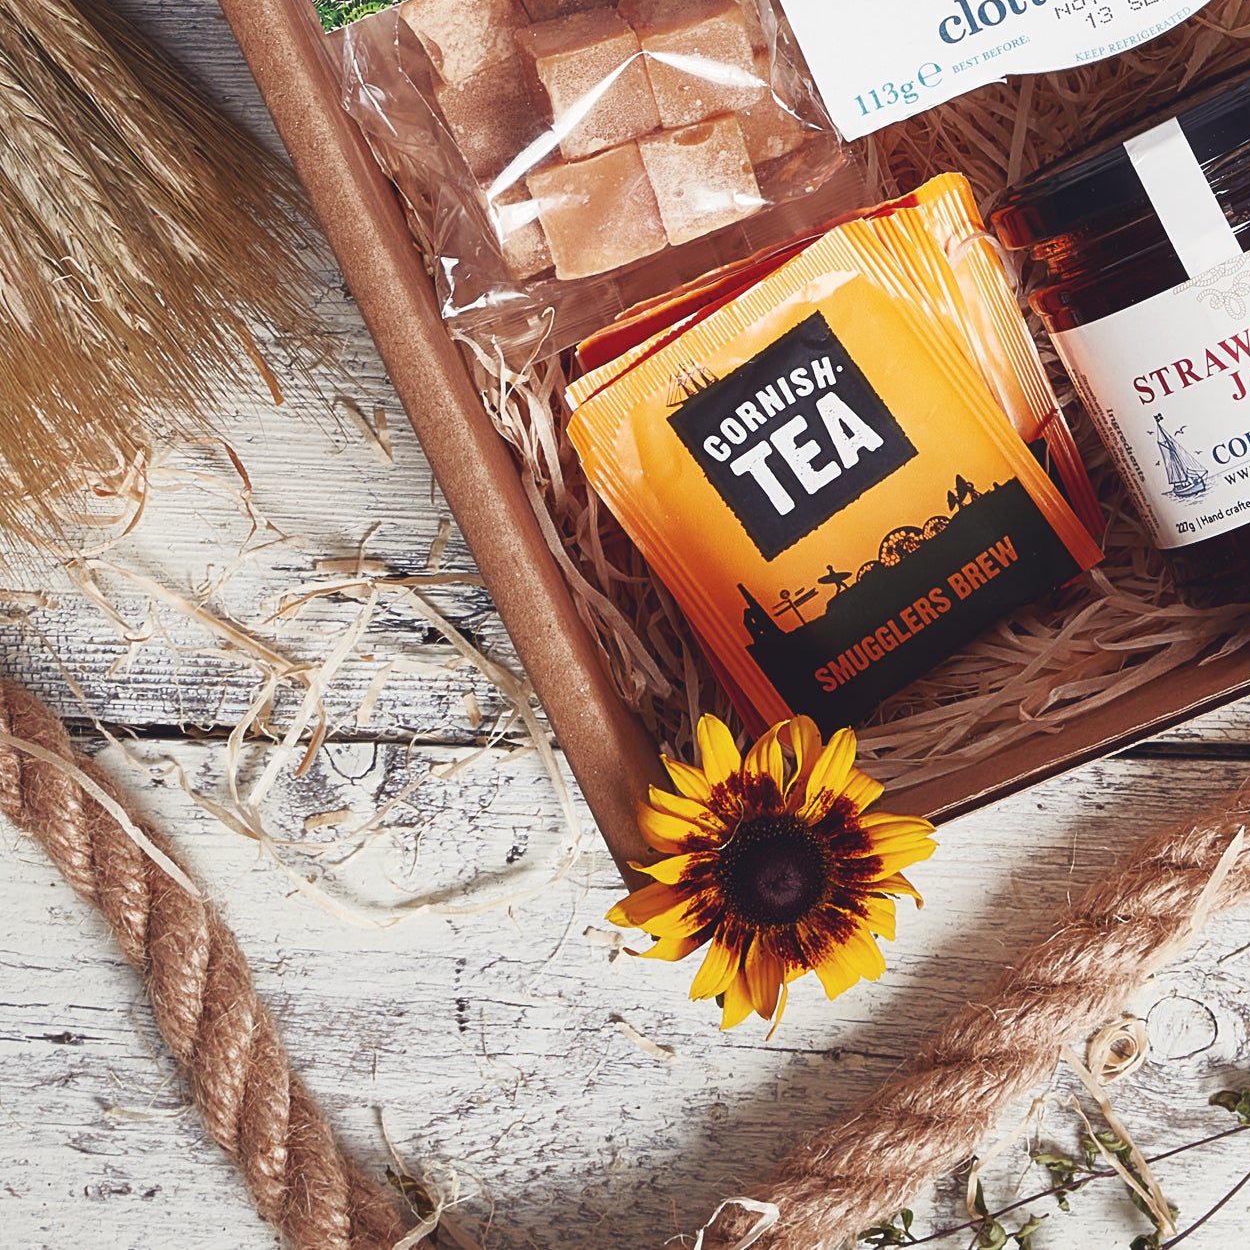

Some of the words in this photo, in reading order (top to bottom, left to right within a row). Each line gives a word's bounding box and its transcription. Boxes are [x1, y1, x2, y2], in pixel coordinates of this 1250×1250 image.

[1074, 45, 1107, 63] KEEP
[1107, 5, 1193, 55] REFRIGERATED
[1084, 6, 1115, 30] 13
[951, 52, 982, 75] BEST
[981, 33, 1033, 64] BEFORE:
[729, 391, 885, 516] TEA
[1106, 408, 1147, 483] Ingredients
[1176, 521, 1196, 534] 227g
[1200, 509, 1225, 526] Hand
[813, 586, 954, 693] SMUGGLERS
[947, 535, 1020, 602] BREW
